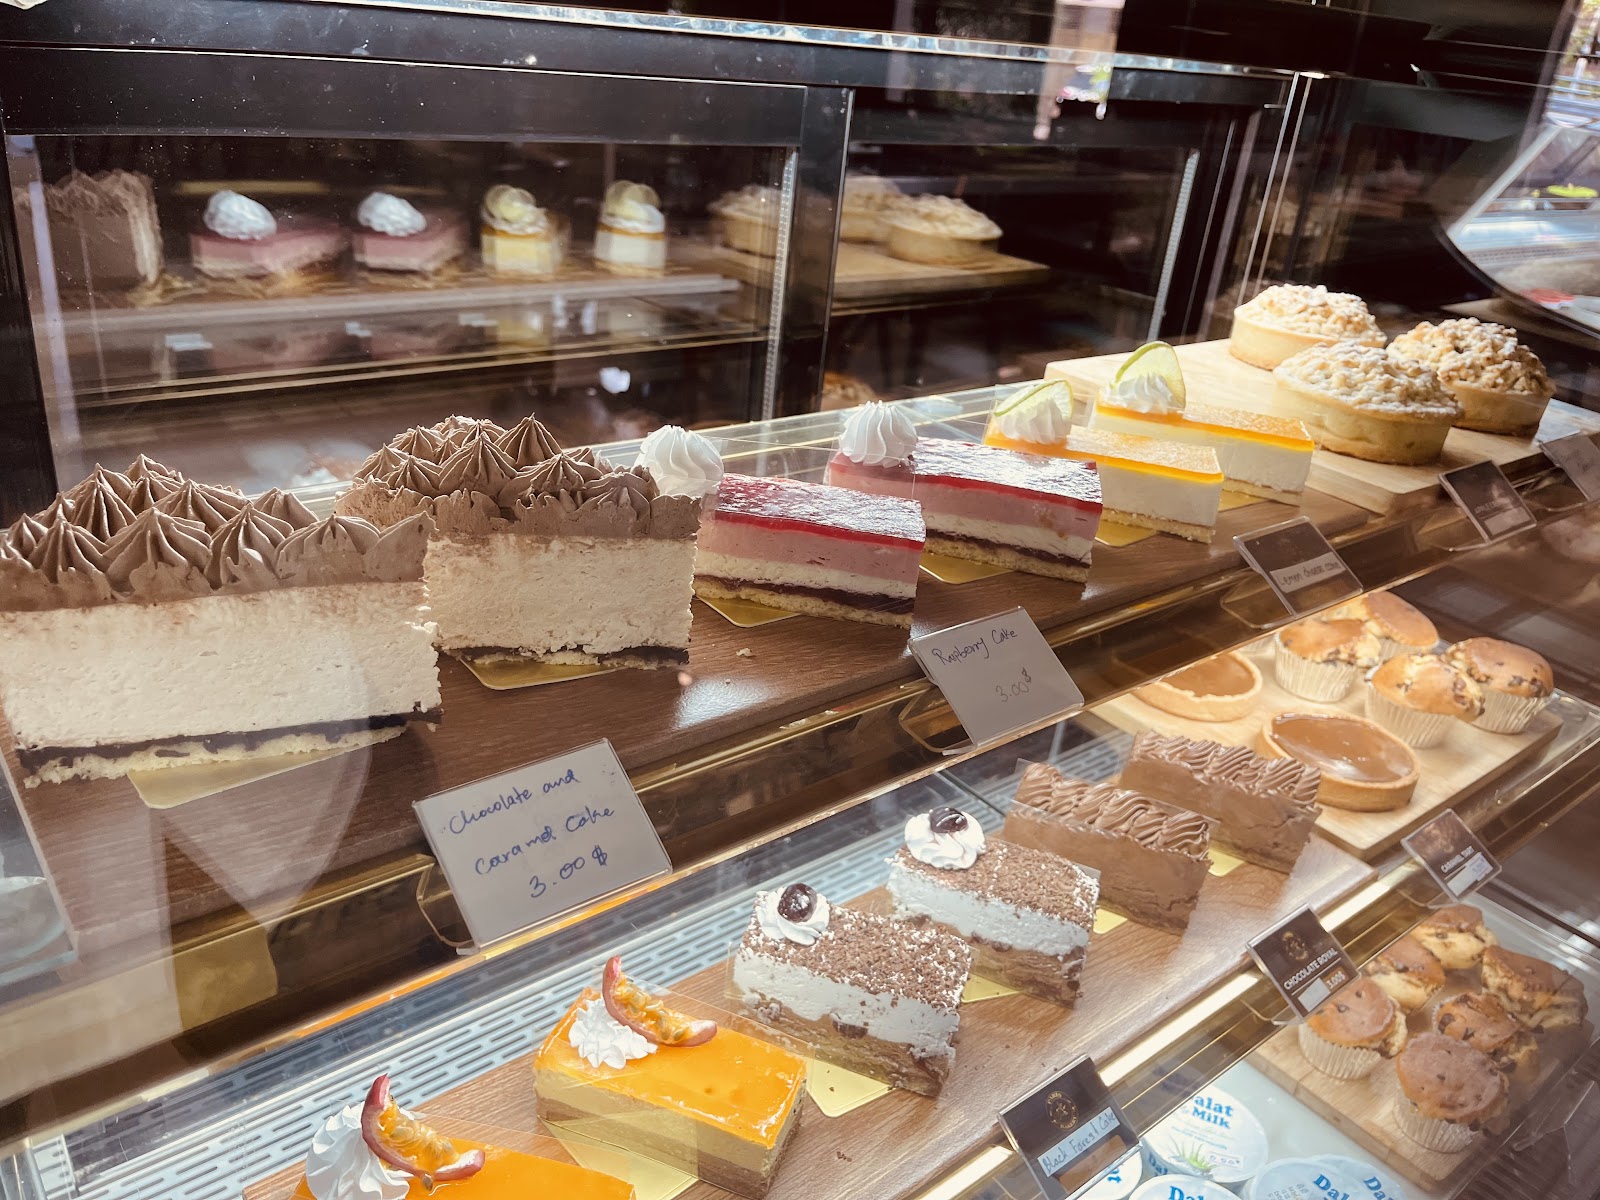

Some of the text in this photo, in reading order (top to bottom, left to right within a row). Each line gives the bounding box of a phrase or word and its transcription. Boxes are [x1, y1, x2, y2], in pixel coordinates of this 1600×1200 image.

[991, 628, 1018, 645] Cake
[448, 768, 582, 834] Chocolate and
[1283, 947, 1339, 990] CHOCOLATE ROYAL
[1191, 1106, 1231, 1129] Milk
[1193, 1095, 1234, 1117] alat
